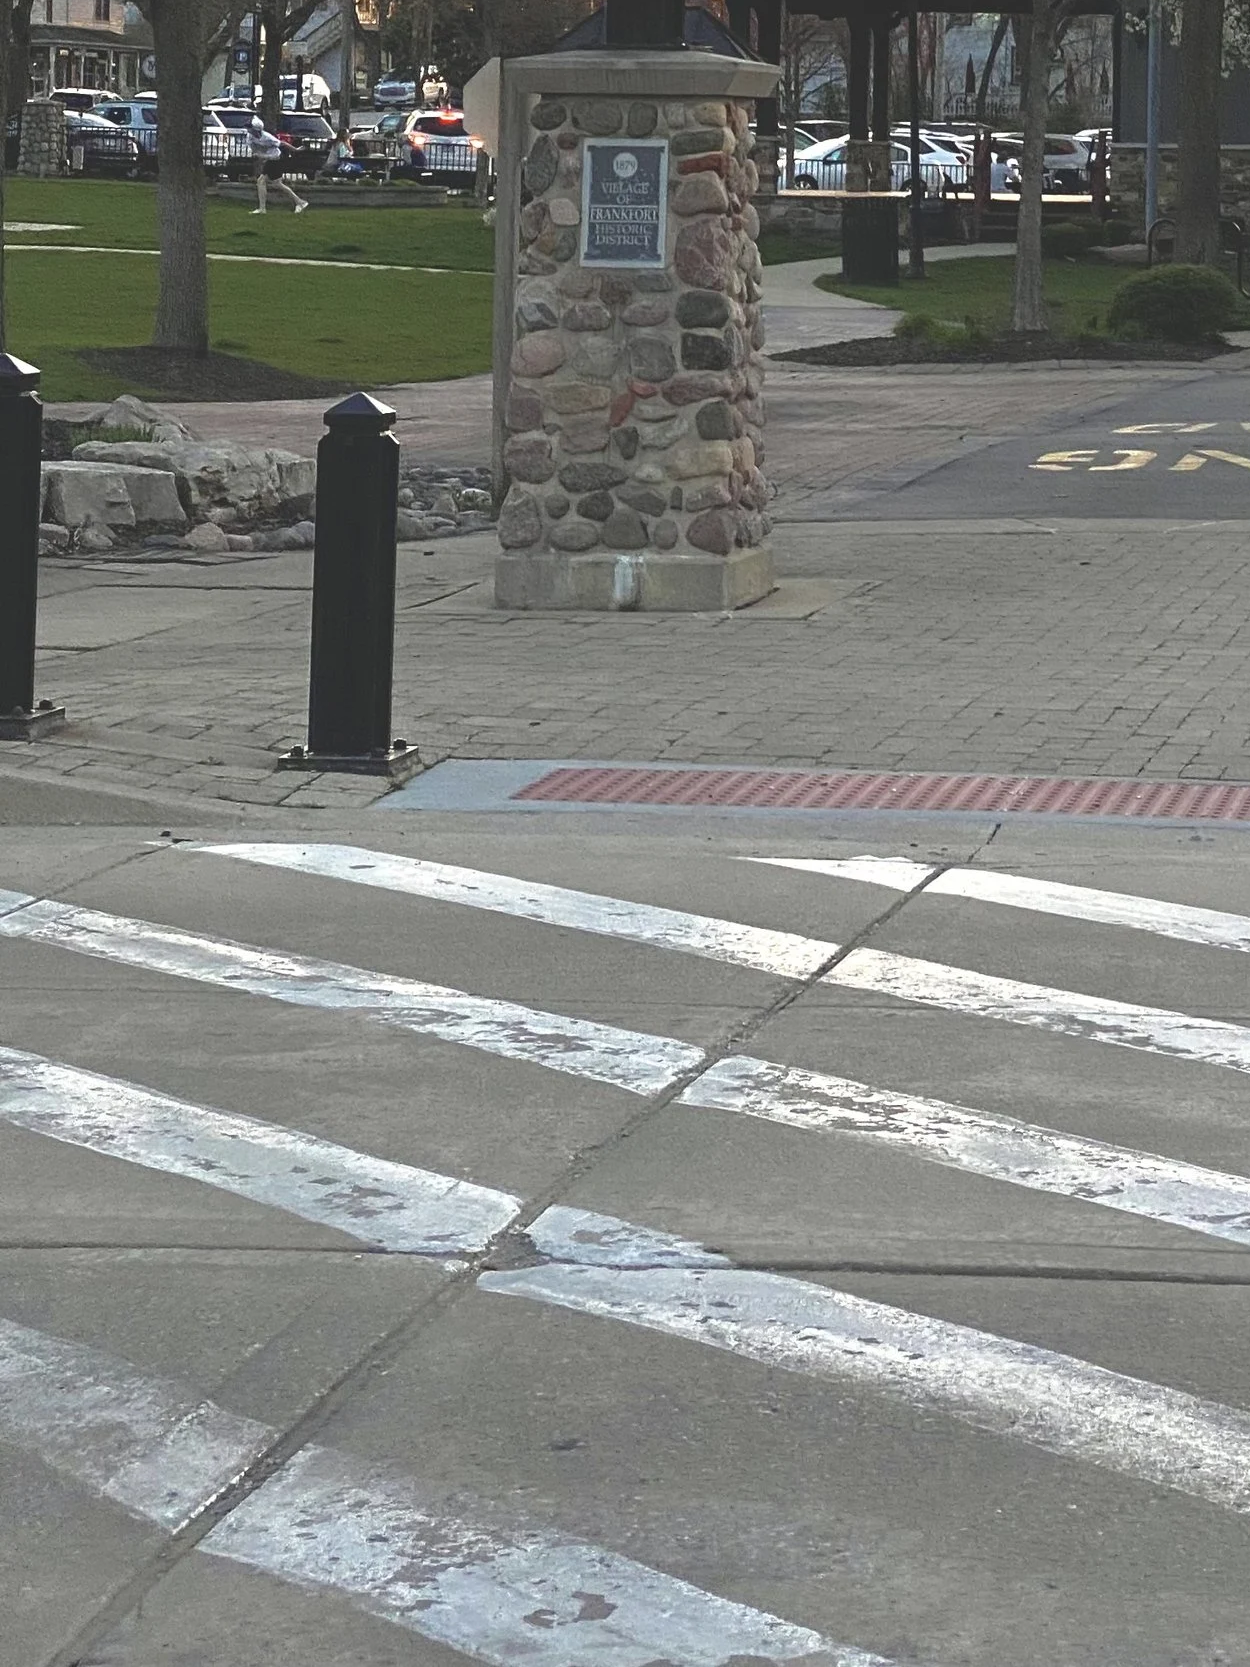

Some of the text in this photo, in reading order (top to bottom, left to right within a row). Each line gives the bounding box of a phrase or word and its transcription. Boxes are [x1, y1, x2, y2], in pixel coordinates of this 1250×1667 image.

[602, 182, 648, 194] VILLAGE
[616, 195, 631, 204] OF
[590, 208, 657, 221] FRANKFORT
[595, 224, 652, 235] HISTORIC
[595, 235, 650, 246] DISTRICT
